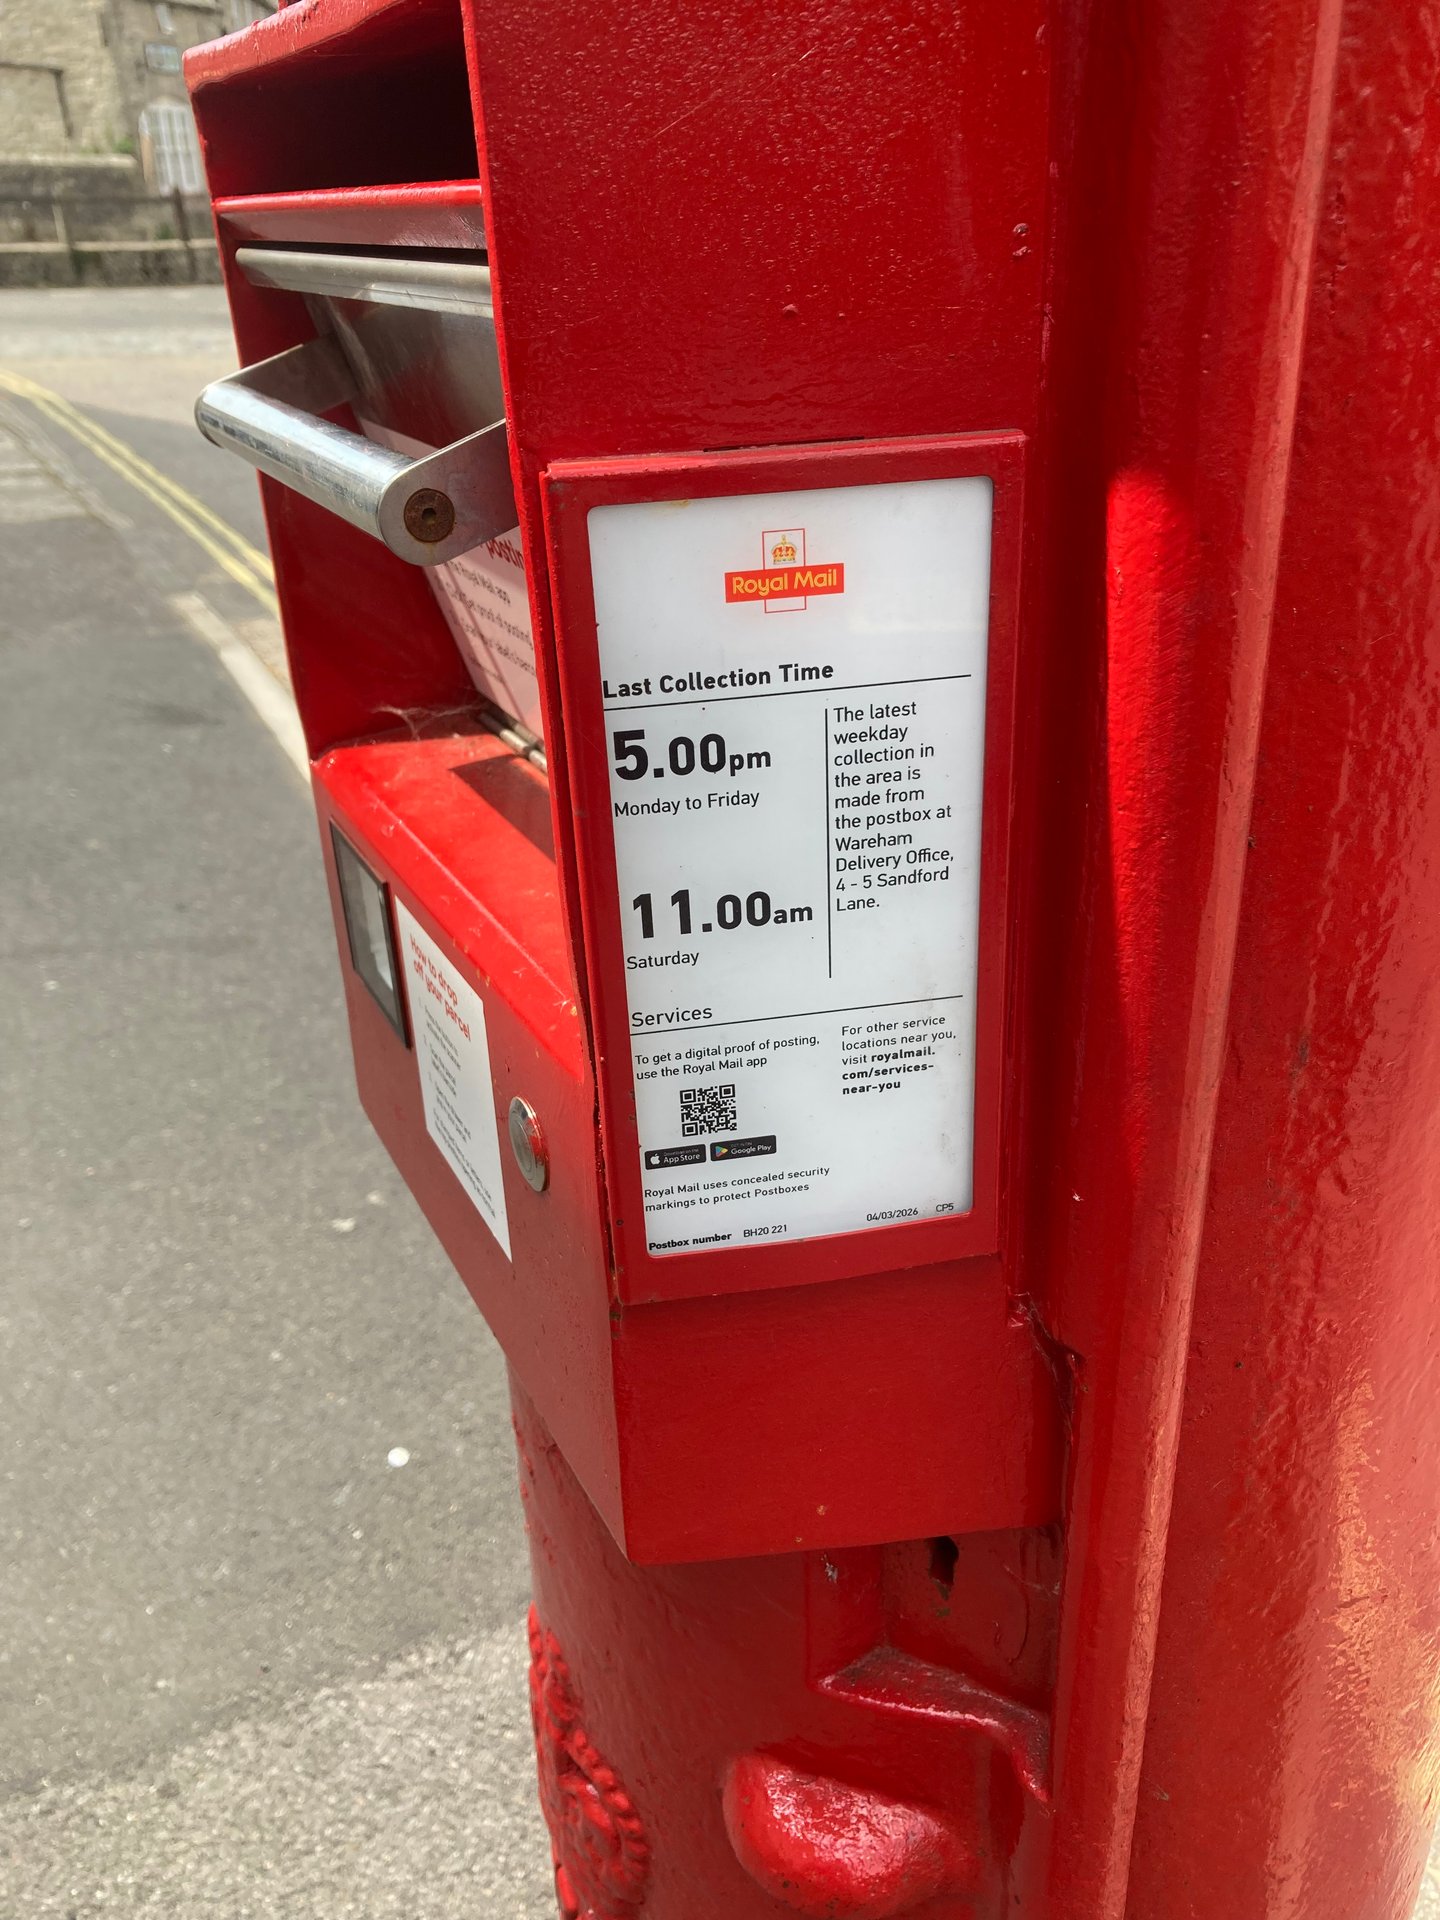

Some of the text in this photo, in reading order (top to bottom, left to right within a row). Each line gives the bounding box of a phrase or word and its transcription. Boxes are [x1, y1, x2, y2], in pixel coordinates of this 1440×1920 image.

[733, 568, 837, 596] Royal Mail
[603, 664, 833, 698] Last Collection Time
[833, 702, 916, 722] The latest
[834, 724, 908, 749] weekday
[613, 729, 771, 780] 5.00pm
[834, 743, 934, 768] collection in
[834, 766, 920, 788] the area is
[614, 790, 759, 817] Monday to Friday
[835, 788, 924, 808] made from
[835, 805, 951, 830] the postbox at
[835, 833, 912, 851] Wareham
[836, 848, 953, 872] Delivery Office,
[836, 878, 845, 891] 4
[863, 875, 872, 889] 5
[877, 866, 948, 887] Sandford
[633, 889, 812, 938] 11.00am
[837, 898, 879, 911] Lane.
[410, 934, 458, 1006] How to drop
[627, 950, 699, 969] Saturday
[425, 975, 442, 1004] your
[444, 1000, 471, 1042] parcel
[632, 1008, 712, 1027] Services
[842, 1017, 945, 1036] For other service
[635, 1055, 649, 1064] To
[652, 1052, 671, 1065] get
[685, 1045, 721, 1060] digital
[724, 1041, 755, 1056] proof
[759, 1039, 770, 1050] of
[774, 1036, 819, 1050] posting,
[842, 1031, 956, 1051] locations near you,
[842, 1046, 935, 1065] visit royalmail.
[637, 1058, 767, 1080] use the Royal Mail app
[842, 1063, 934, 1080] com/services-
[843, 1082, 900, 1094] near-you
[663, 1156, 680, 1164] App
[680, 1153, 700, 1161] Store
[731, 1146, 756, 1155] Google
[757, 1144, 772, 1152] Play
[645, 1167, 830, 1198] Royal Mail uses concealed security
[645, 1198, 696, 1212] markings
[713, 1190, 750, 1204] protect
[755, 1184, 809, 1197] Postboxes
[936, 1203, 954, 1212] CP5
[867, 1208, 918, 1221] 04/03/2026
[649, 1224, 786, 1250] Postbox number BH20 221
